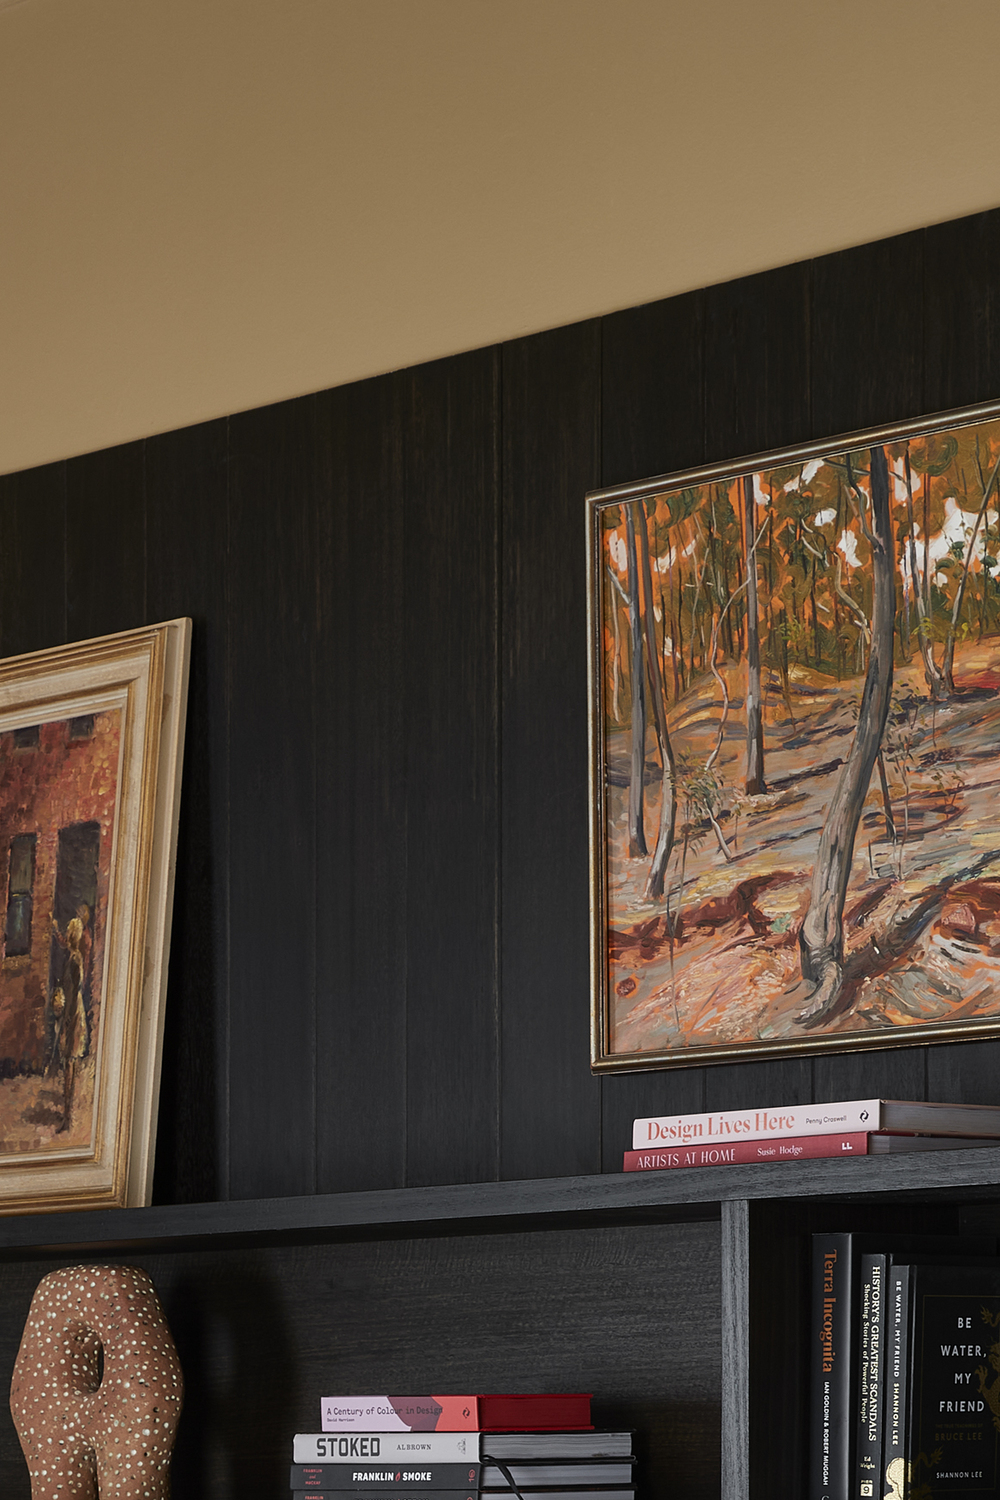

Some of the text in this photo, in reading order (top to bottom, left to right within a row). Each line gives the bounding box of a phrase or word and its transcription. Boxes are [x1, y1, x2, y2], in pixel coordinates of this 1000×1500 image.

[647, 1112, 795, 1143] Design Lives Here
[757, 1144, 803, 1156] Susie Hodge
[636, 1148, 736, 1168] ARTISTS AT HOME
[895, 1281, 902, 1291] BE
[862, 1284, 870, 1319] Shocking
[819, 1249, 837, 1373] Terra Incognita
[957, 1317, 972, 1329] BE
[894, 1330, 901, 1343] MY
[862, 1350, 869, 1360] of
[868, 1266, 880, 1442] HISTORY'S GREATEST SCANDALS
[940, 1345, 987, 1358] WATER,
[893, 1346, 901, 1377] FRIEND
[954, 1373, 972, 1384] MY
[333, 1407, 363, 1416] Century
[366, 1407, 375, 1415] of
[376, 1407, 402, 1415] Colour
[405, 1406, 415, 1415] in
[416, 1406, 443, 1416] Design
[860, 1398, 868, 1423] People
[939, 1401, 985, 1412] FRIEND
[316, 1437, 381, 1457] STOKED
[352, 1472, 432, 1481] FRANKLIN SMOKE
